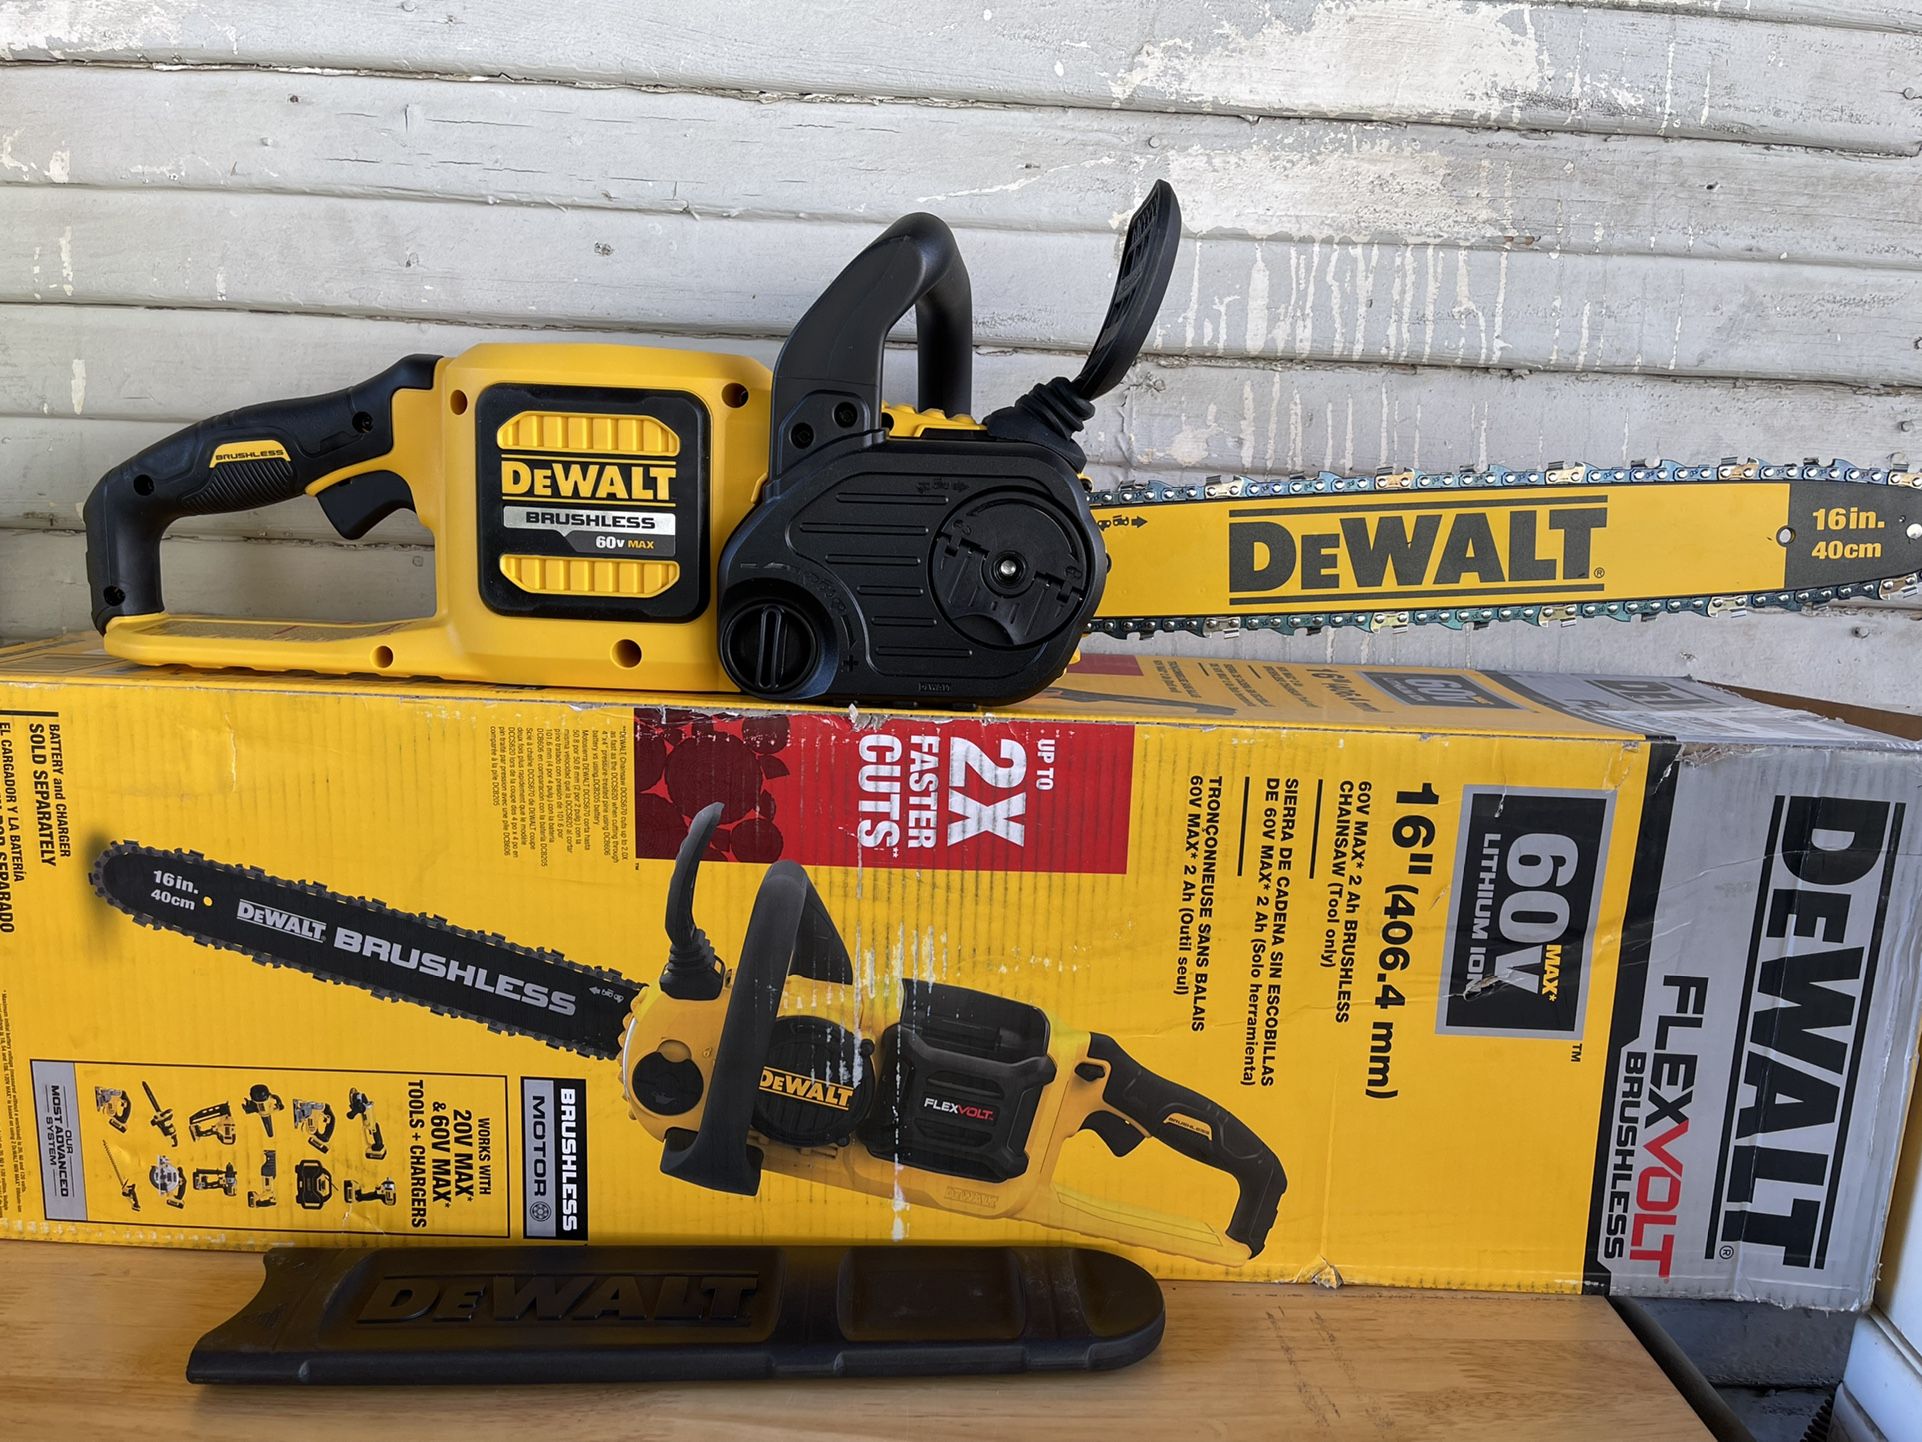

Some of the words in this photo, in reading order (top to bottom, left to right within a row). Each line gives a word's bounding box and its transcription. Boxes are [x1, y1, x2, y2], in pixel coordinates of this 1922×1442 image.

[216, 450, 284, 460] BRUSHLESS
[501, 460, 676, 500] DEWALT
[526, 511, 656, 529] BRUSHLESS
[1812, 507, 1885, 530] 16in.
[628, 540, 654, 549] MAX
[1228, 507, 1608, 592] DEWALT
[1811, 540, 1882, 560] 40cm
[0, 722, 11, 736] EL
[29, 723, 47, 765] SOLD
[49, 724, 64, 775] BATTERY
[1036, 738, 1054, 763] UP
[1, 739, 17, 803] CARGADOR
[53, 778, 66, 800] and
[907, 734, 939, 848] FASTER
[1036, 768, 1054, 790] TO
[1265, 778, 1280, 802] DE
[946, 736, 1026, 847] 2X
[1189, 775, 1203, 808] 60V
[1280, 778, 1299, 842] SIERRA
[1356, 781, 1372, 815] 60V
[8, 817, 20, 831] LA
[33, 770, 56, 867] SEPARATELY
[55, 803, 71, 857] CHARGER
[1262, 807, 1277, 840] 60V
[1332, 780, 1354, 877] CHAINSAW
[10, 835, 27, 882] BATERÍA
[1199, 776, 1223, 918] TRONÇONNEUSE
[1278, 847, 1293, 871] DE
[1184, 865, 1197, 875] 2
[1348, 875, 1362, 886] 2
[1472, 833, 1502, 939] LITHIUM
[150, 888, 196, 910] 40cm
[1182, 880, 1196, 902] Ah
[1256, 895, 1269, 906] 2
[1271, 876, 1290, 946] CADENA
[1327, 882, 1344, 923] (Tool
[1345, 891, 1361, 914] Ah
[236, 905, 326, 943] DEWALT
[1178, 908, 1194, 951] (Outil
[1254, 911, 1268, 933] Ah
[1494, 833, 1579, 994] 60V
[1196, 923, 1211, 968] SANS
[1250, 938, 1266, 978] (Solo
[1269, 951, 1284, 978] SIN
[1320, 929, 1337, 968] only)
[1374, 884, 1419, 1009] (406.4
[334, 926, 577, 1016] BRUSHLESS
[1173, 957, 1189, 995] seul)
[1335, 920, 1358, 1023] BRUSHLESS
[1466, 947, 1487, 993] ION
[1191, 973, 1208, 1032] BALAIS
[1240, 983, 1263, 1086] herramienta)
[1261, 984, 1281, 1086] ESCOBILLAS
[1722, 796, 1891, 1270] DEWALT
[1365, 1021, 1399, 1099] mm)
[51, 1085, 63, 1124] MOST
[408, 1079, 425, 1129] TOOLS
[432, 1101, 446, 1112] &
[760, 1069, 854, 1106] DEWALT
[453, 1109, 473, 1147] 20V
[924, 1098, 992, 1120] FLEXVOLT
[1630, 975, 1709, 1278] FLEXVOLT
[46, 1117, 57, 1165] SYSTEM
[65, 1129, 74, 1154] OUR
[412, 1132, 421, 1141] +
[431, 1115, 451, 1153] 60V
[478, 1118, 491, 1162] WORKS
[532, 1095, 547, 1196] MOTOR
[1605, 1050, 1648, 1258] BRUSHLESS
[55, 1125, 69, 1197] ADVANCED
[561, 1088, 577, 1231] BRUSHLESS
[410, 1145, 427, 1228] CHARGERS
[479, 1165, 491, 1195] WITH
[357, 1276, 758, 1324] DEWALT
